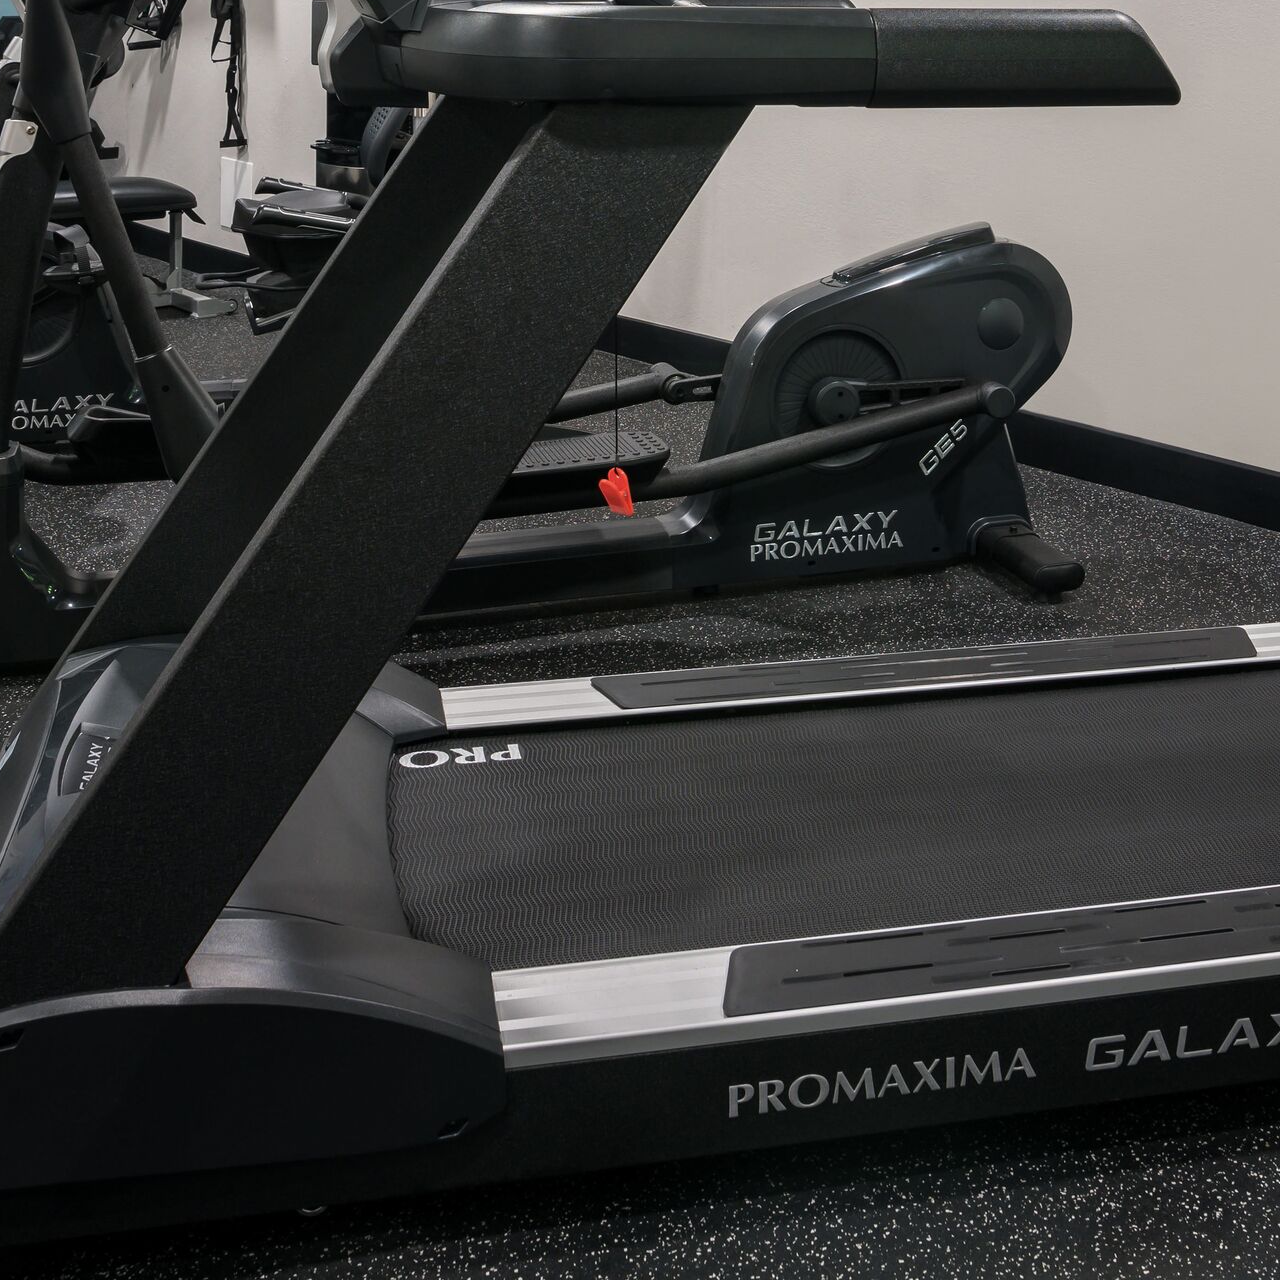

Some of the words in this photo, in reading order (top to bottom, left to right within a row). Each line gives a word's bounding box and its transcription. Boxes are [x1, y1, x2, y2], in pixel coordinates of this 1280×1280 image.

[919, 418, 968, 476] GE5
[750, 531, 904, 562] PROMAXIMA
[753, 509, 898, 543] GALAXY
[727, 1047, 1037, 1119] PROMAXIMA
